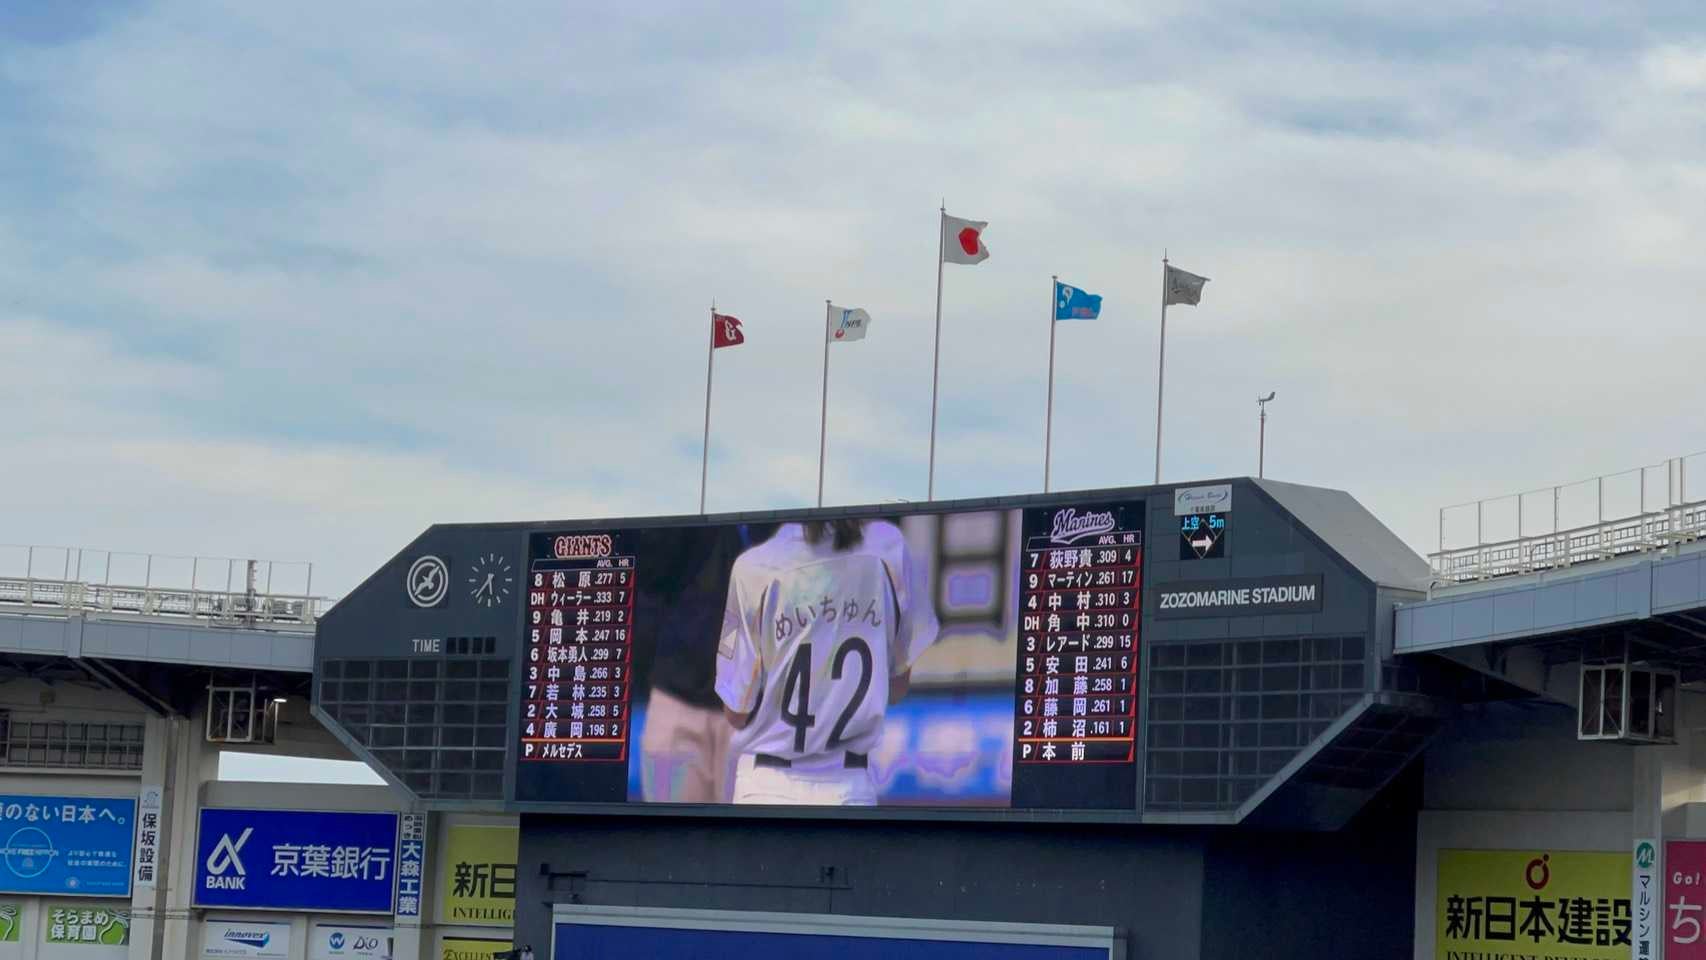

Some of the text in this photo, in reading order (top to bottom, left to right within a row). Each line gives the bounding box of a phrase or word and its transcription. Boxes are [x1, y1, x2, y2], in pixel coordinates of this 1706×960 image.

[1050, 508, 1115, 543] Marines
[1182, 515, 1224, 530] 上空 5m
[554, 534, 612, 558] GIANTS
[1099, 534, 1135, 544] AVG. HR
[596, 560, 613, 568] AVG.
[1030, 553, 1039, 567] 7
[1097, 550, 1117, 563] .309
[1125, 549, 1131, 561] 4
[534, 574, 543, 587] 8
[594, 572, 613, 584] .277
[620, 572, 626, 584] 5
[1029, 571, 1133, 588] 9 マーティン .261 17
[531, 591, 625, 606] DH ウィーラー .333 7
[1028, 595, 1037, 609] 4
[1096, 593, 1115, 606] .310
[1123, 592, 1130, 604] 3
[1160, 585, 1315, 609] ZOZOMARINE STADIUM
[533, 611, 541, 624] 9
[592, 610, 611, 622] .219
[618, 610, 624, 622] 2
[776, 596, 882, 641] めいちゅん
[1024, 616, 1039, 630] DH
[1095, 615, 1115, 627] .310
[1123, 614, 1129, 626] 0
[532, 629, 540, 642] 5
[592, 629, 610, 641] .247
[615, 629, 625, 640] 16
[1027, 634, 1131, 652] 3 レアード .299 15
[412, 639, 440, 653] TIME
[530, 646, 622, 662] 6 坂本勇人 .299 7
[1026, 658, 1034, 672] 5
[1093, 657, 1112, 670] .241
[1121, 657, 1128, 669] 6
[529, 667, 537, 680] 3
[589, 667, 608, 679] .266
[615, 667, 620, 678] 3
[529, 686, 536, 698] 7
[588, 686, 607, 698] .235
[614, 686, 619, 697] 3
[1025, 678, 1033, 693] 8
[1092, 678, 1112, 691] .258
[1121, 678, 1125, 690] 1
[781, 636, 872, 752] 42
[527, 704, 535, 717] 2
[588, 705, 606, 717] .258
[613, 705, 619, 716] 5
[1024, 699, 1033, 714] 6
[1091, 700, 1110, 712] .261
[1120, 700, 1124, 712] 1
[526, 723, 535, 736] 4
[586, 724, 605, 736] .196
[612, 725, 618, 736] 2
[1024, 721, 1032, 735] 2
[1090, 722, 1109, 734] .161
[1120, 721, 1124, 733] 1
[525, 742, 582, 758] P メルセデス
[1022, 744, 1032, 759] P
[138, 813, 157, 881] 保坂設備
[270, 844, 390, 880] 京葉銀行
[206, 876, 245, 890] BANK
[399, 842, 420, 914] 大森工業
[453, 861, 517, 898] 新日
[1673, 872, 1700, 885] Go!
[53, 909, 108, 925] そらまめ
[453, 907, 515, 920] INTELLIG
[1446, 894, 1632, 946] 新日本建設
[1669, 896, 1702, 944] ち
[52, 925, 96, 940] 保育園
